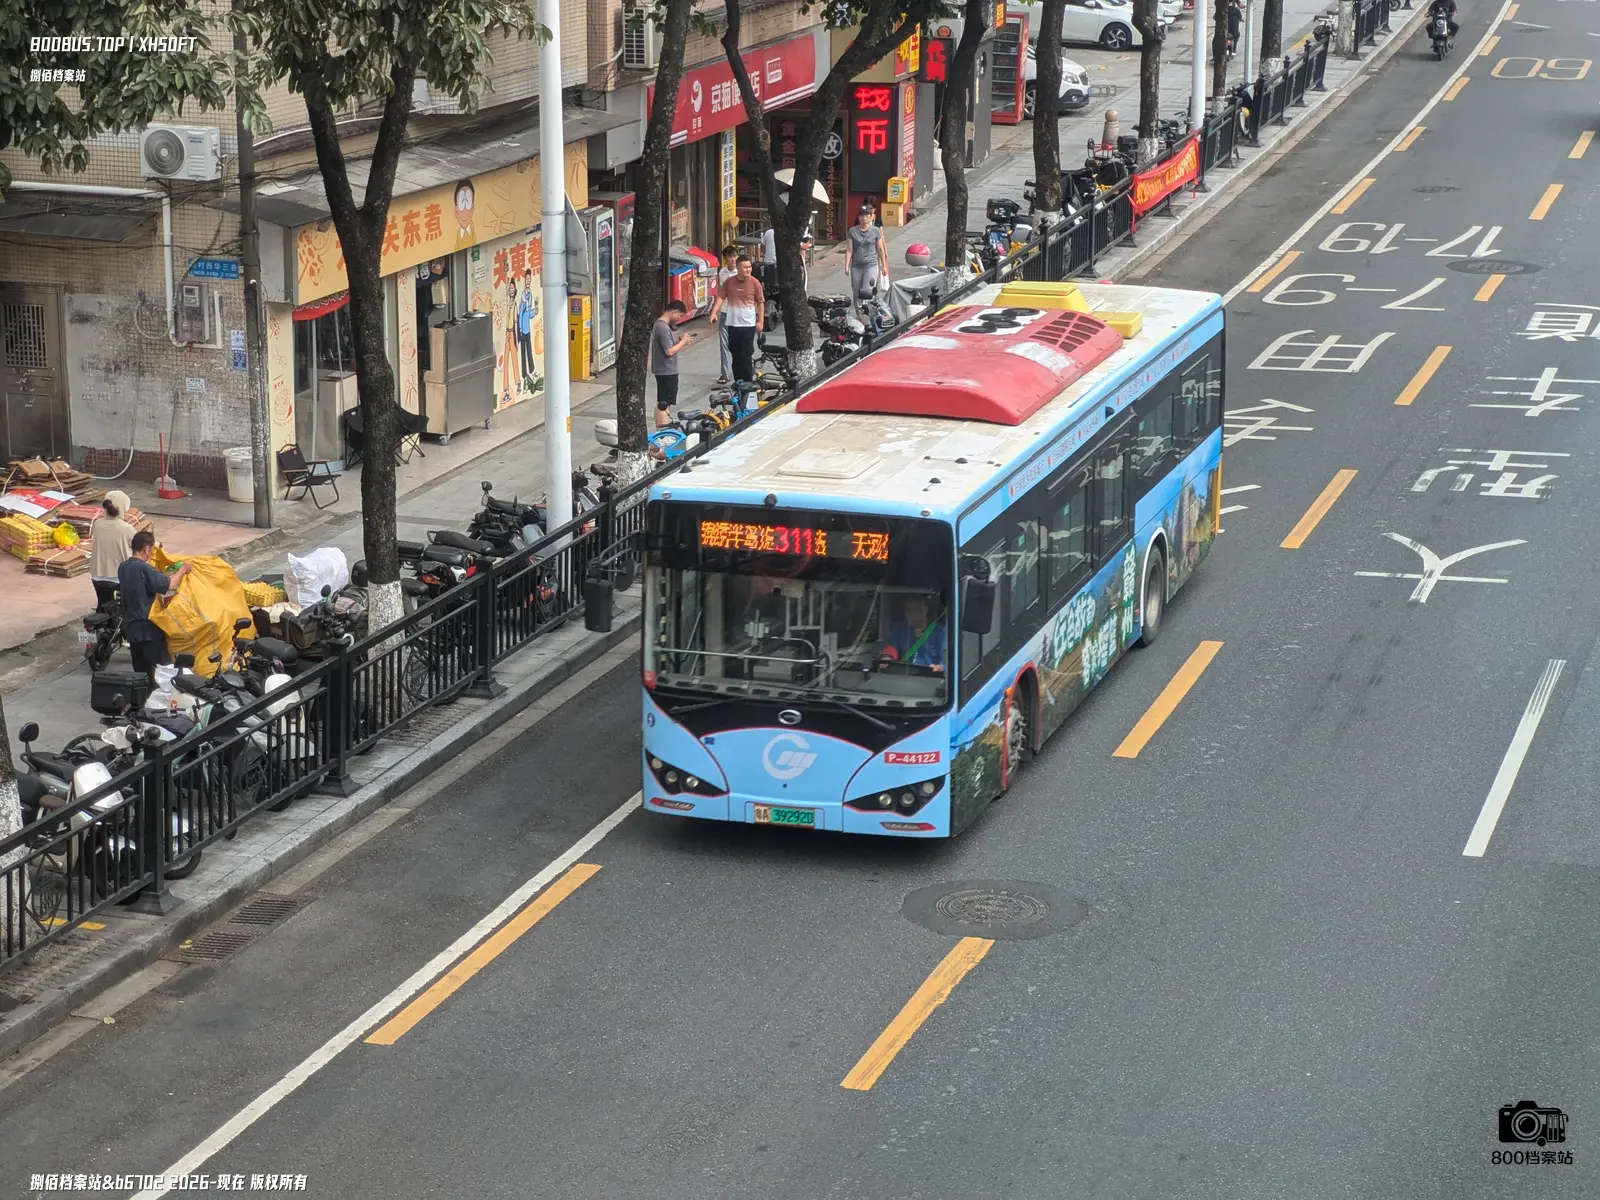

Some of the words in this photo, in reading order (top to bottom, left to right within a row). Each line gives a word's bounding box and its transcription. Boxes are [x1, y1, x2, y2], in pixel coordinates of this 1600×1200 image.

[711, 70, 760, 114] 京猫便店
[888, 752, 937, 764] P-44122
